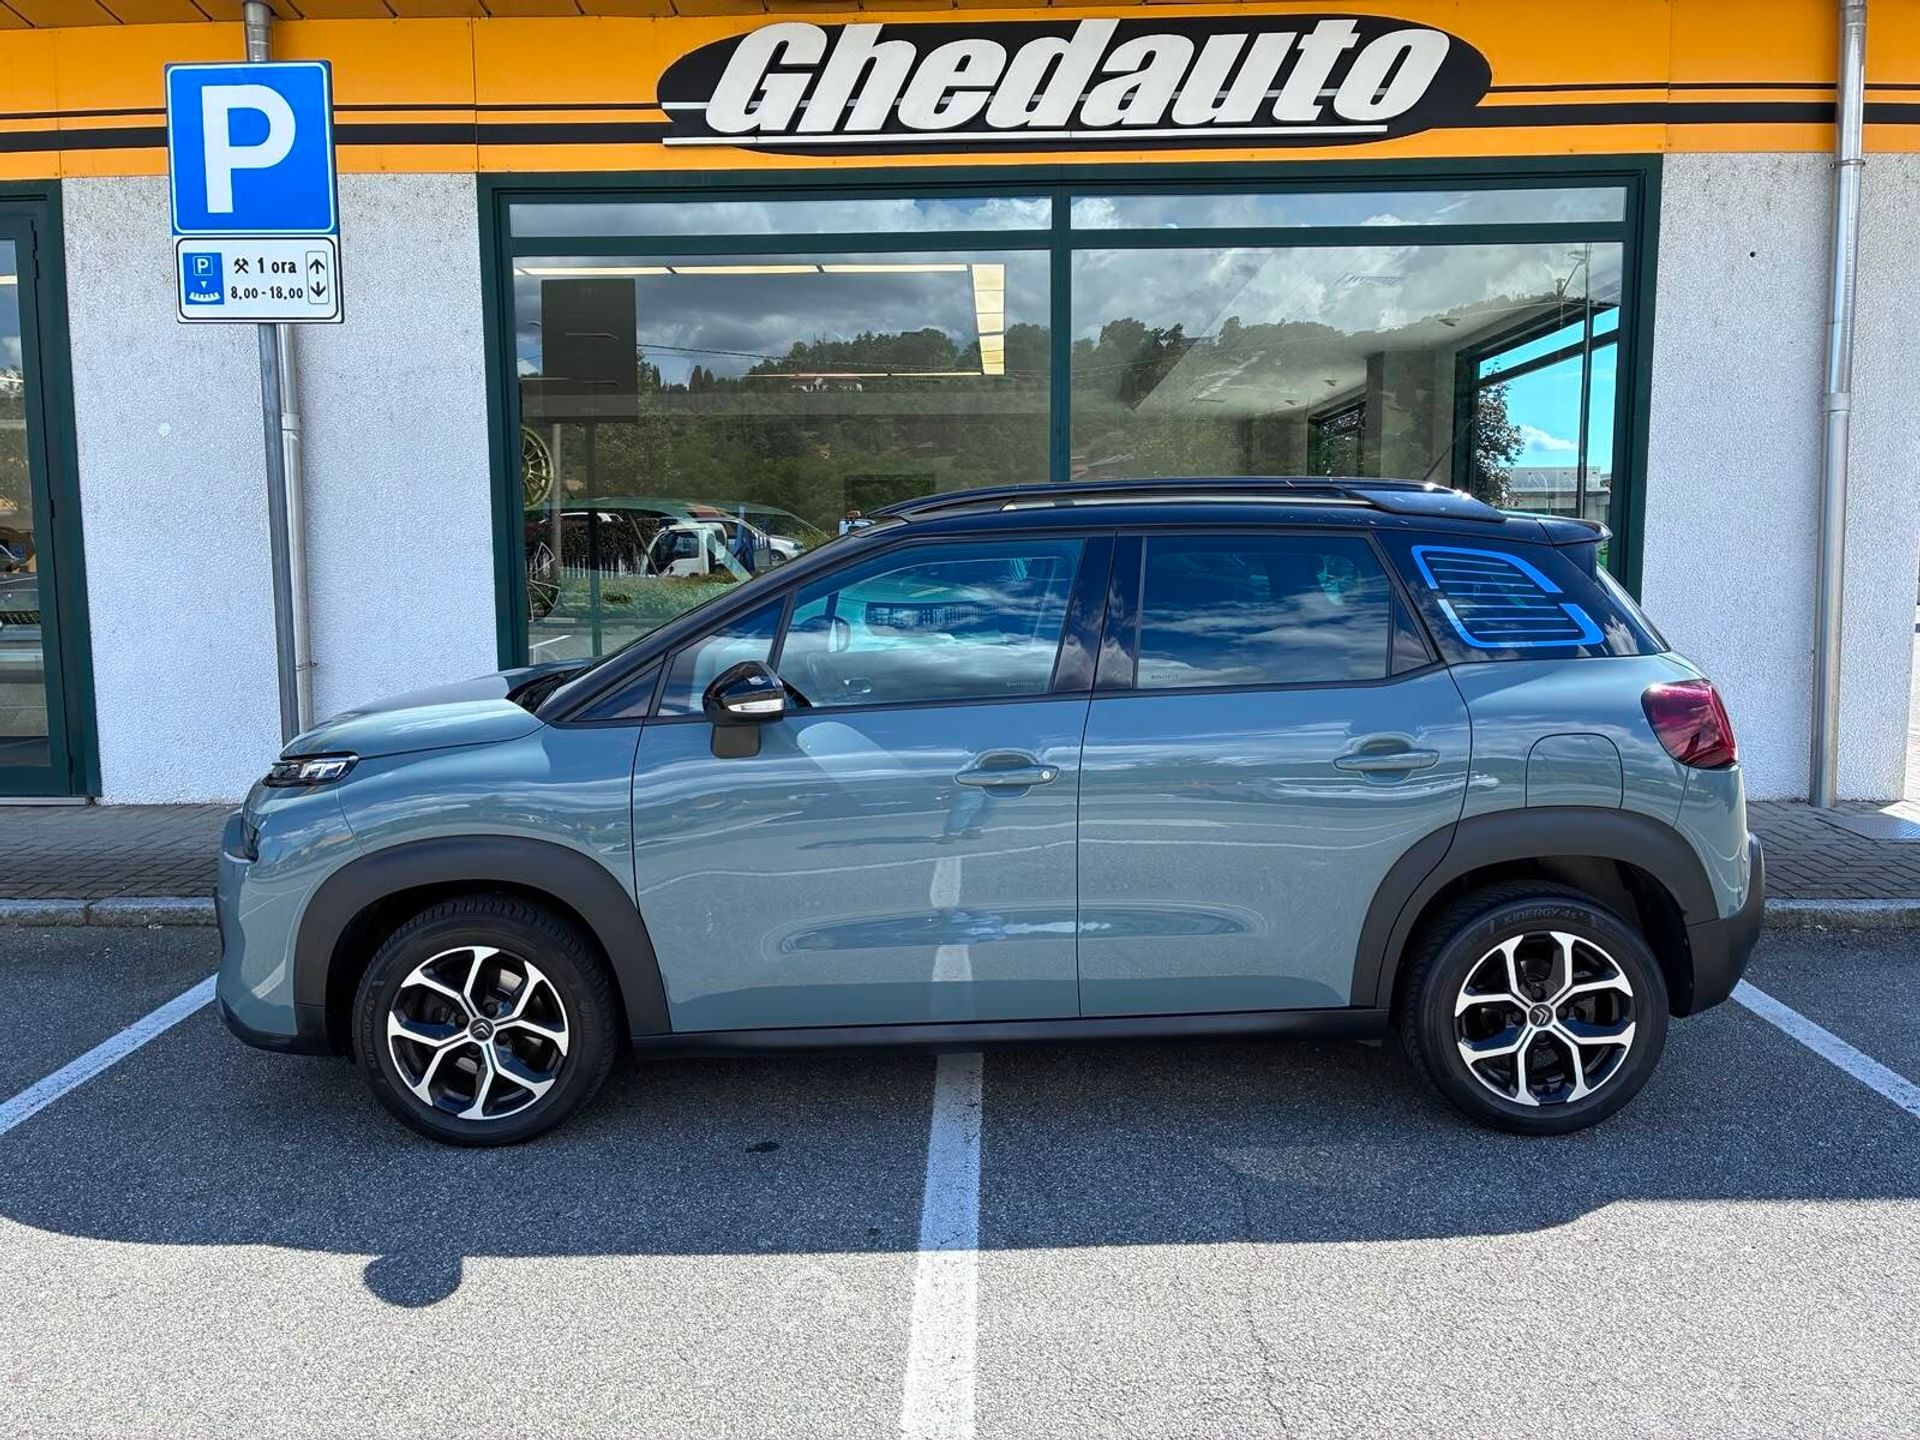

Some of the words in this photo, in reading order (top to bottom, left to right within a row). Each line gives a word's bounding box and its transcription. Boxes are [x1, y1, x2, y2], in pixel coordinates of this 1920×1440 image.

[705, 18, 1450, 134] Ghedauto
[201, 84, 296, 214] P
[196, 258, 209, 274] P
[257, 257, 264, 274] 1
[271, 261, 297, 274] ora
